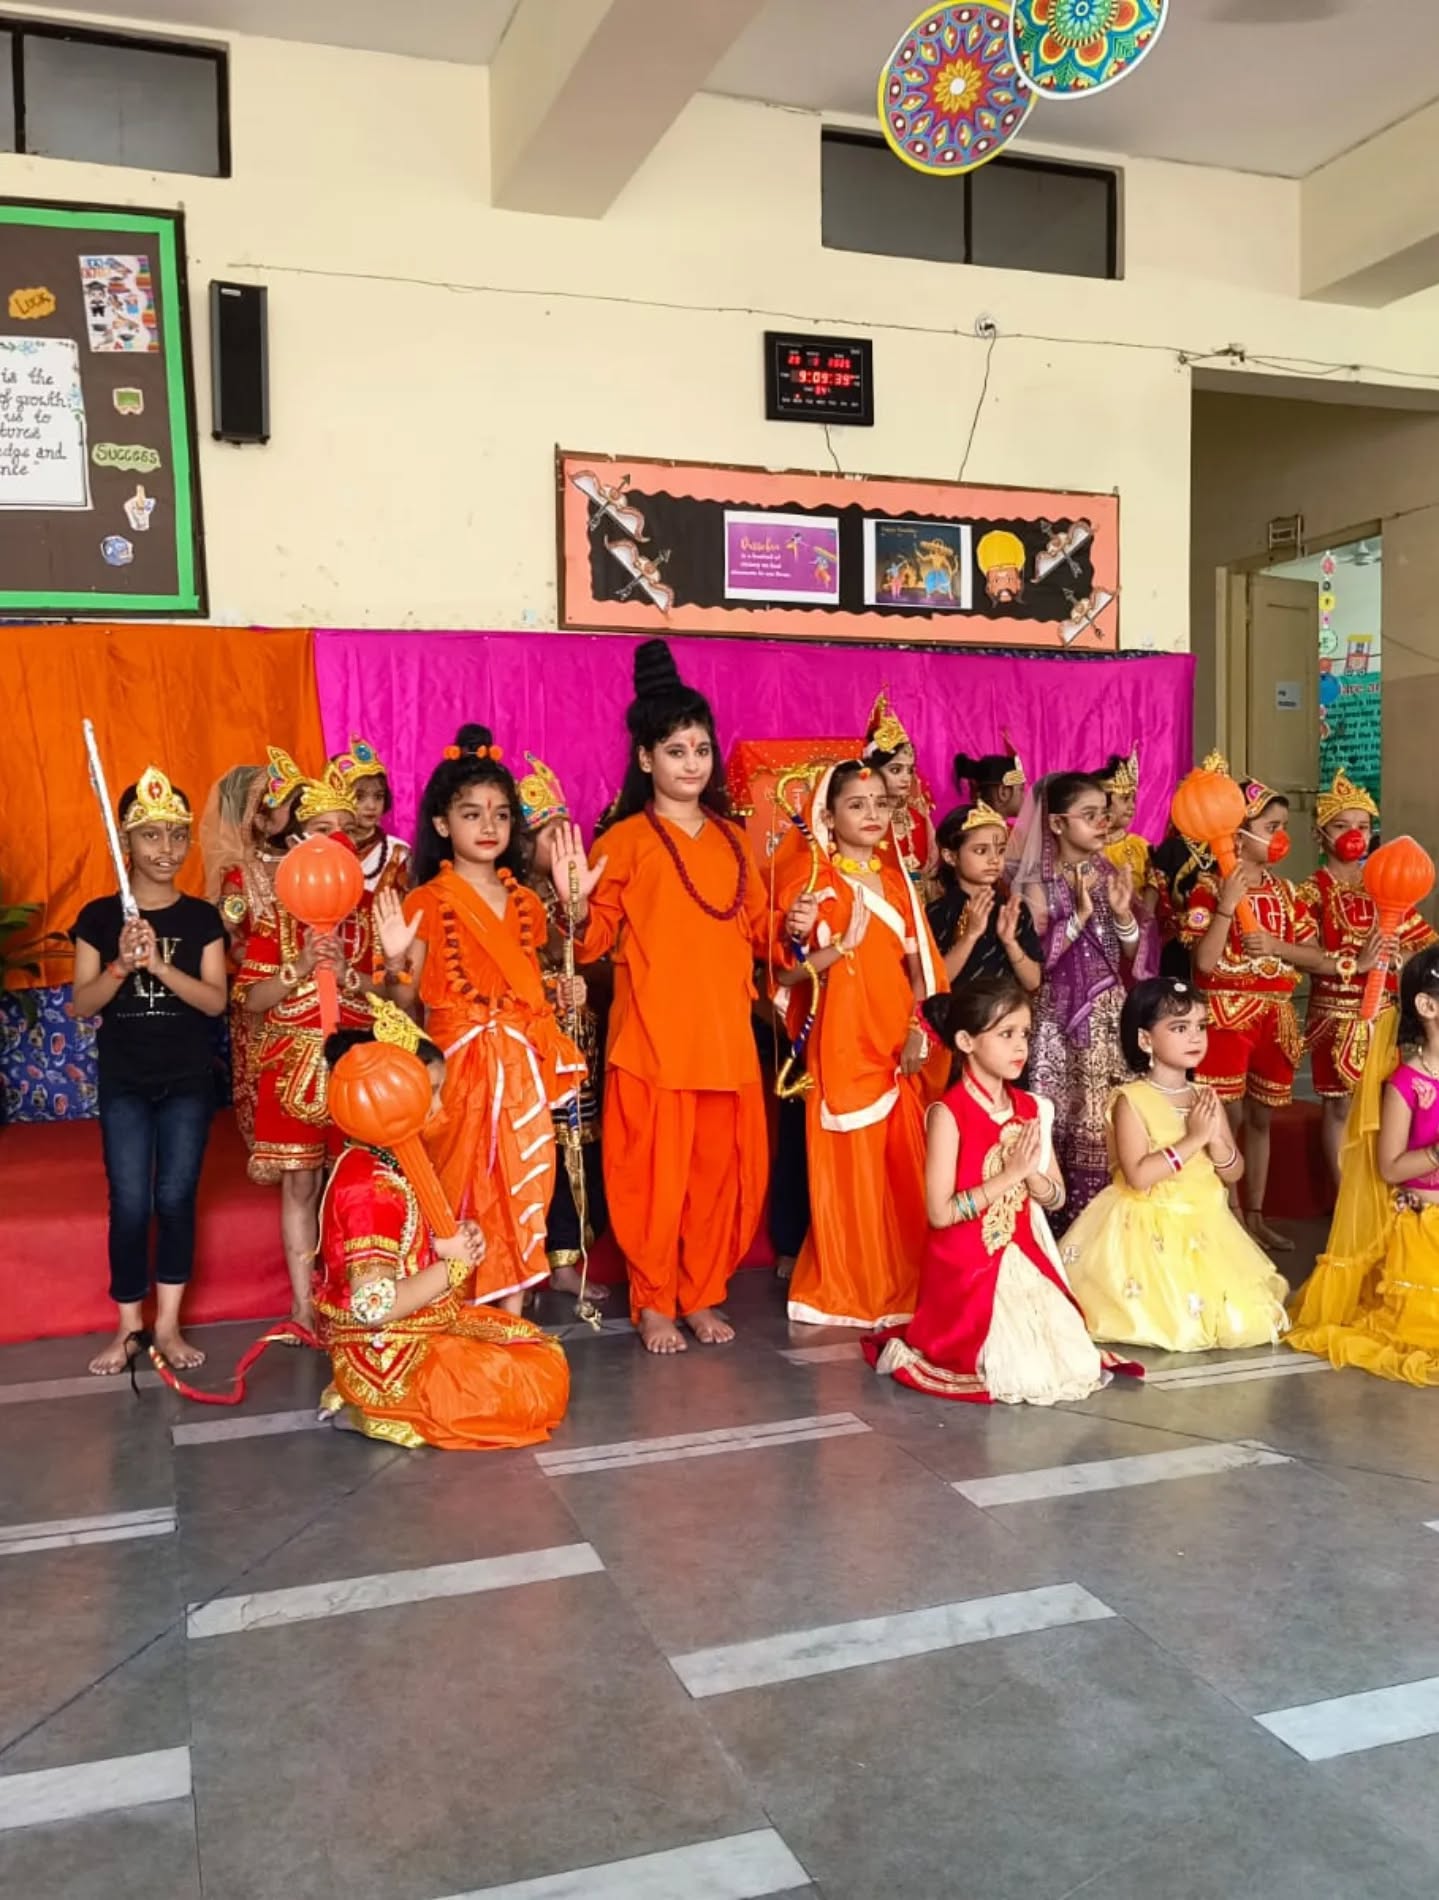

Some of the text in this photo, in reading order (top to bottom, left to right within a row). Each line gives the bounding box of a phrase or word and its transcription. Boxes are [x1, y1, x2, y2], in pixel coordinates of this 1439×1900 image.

[28, 367, 54, 385] the
[34, 409, 51, 424] to
[36, 441, 67, 460] and
